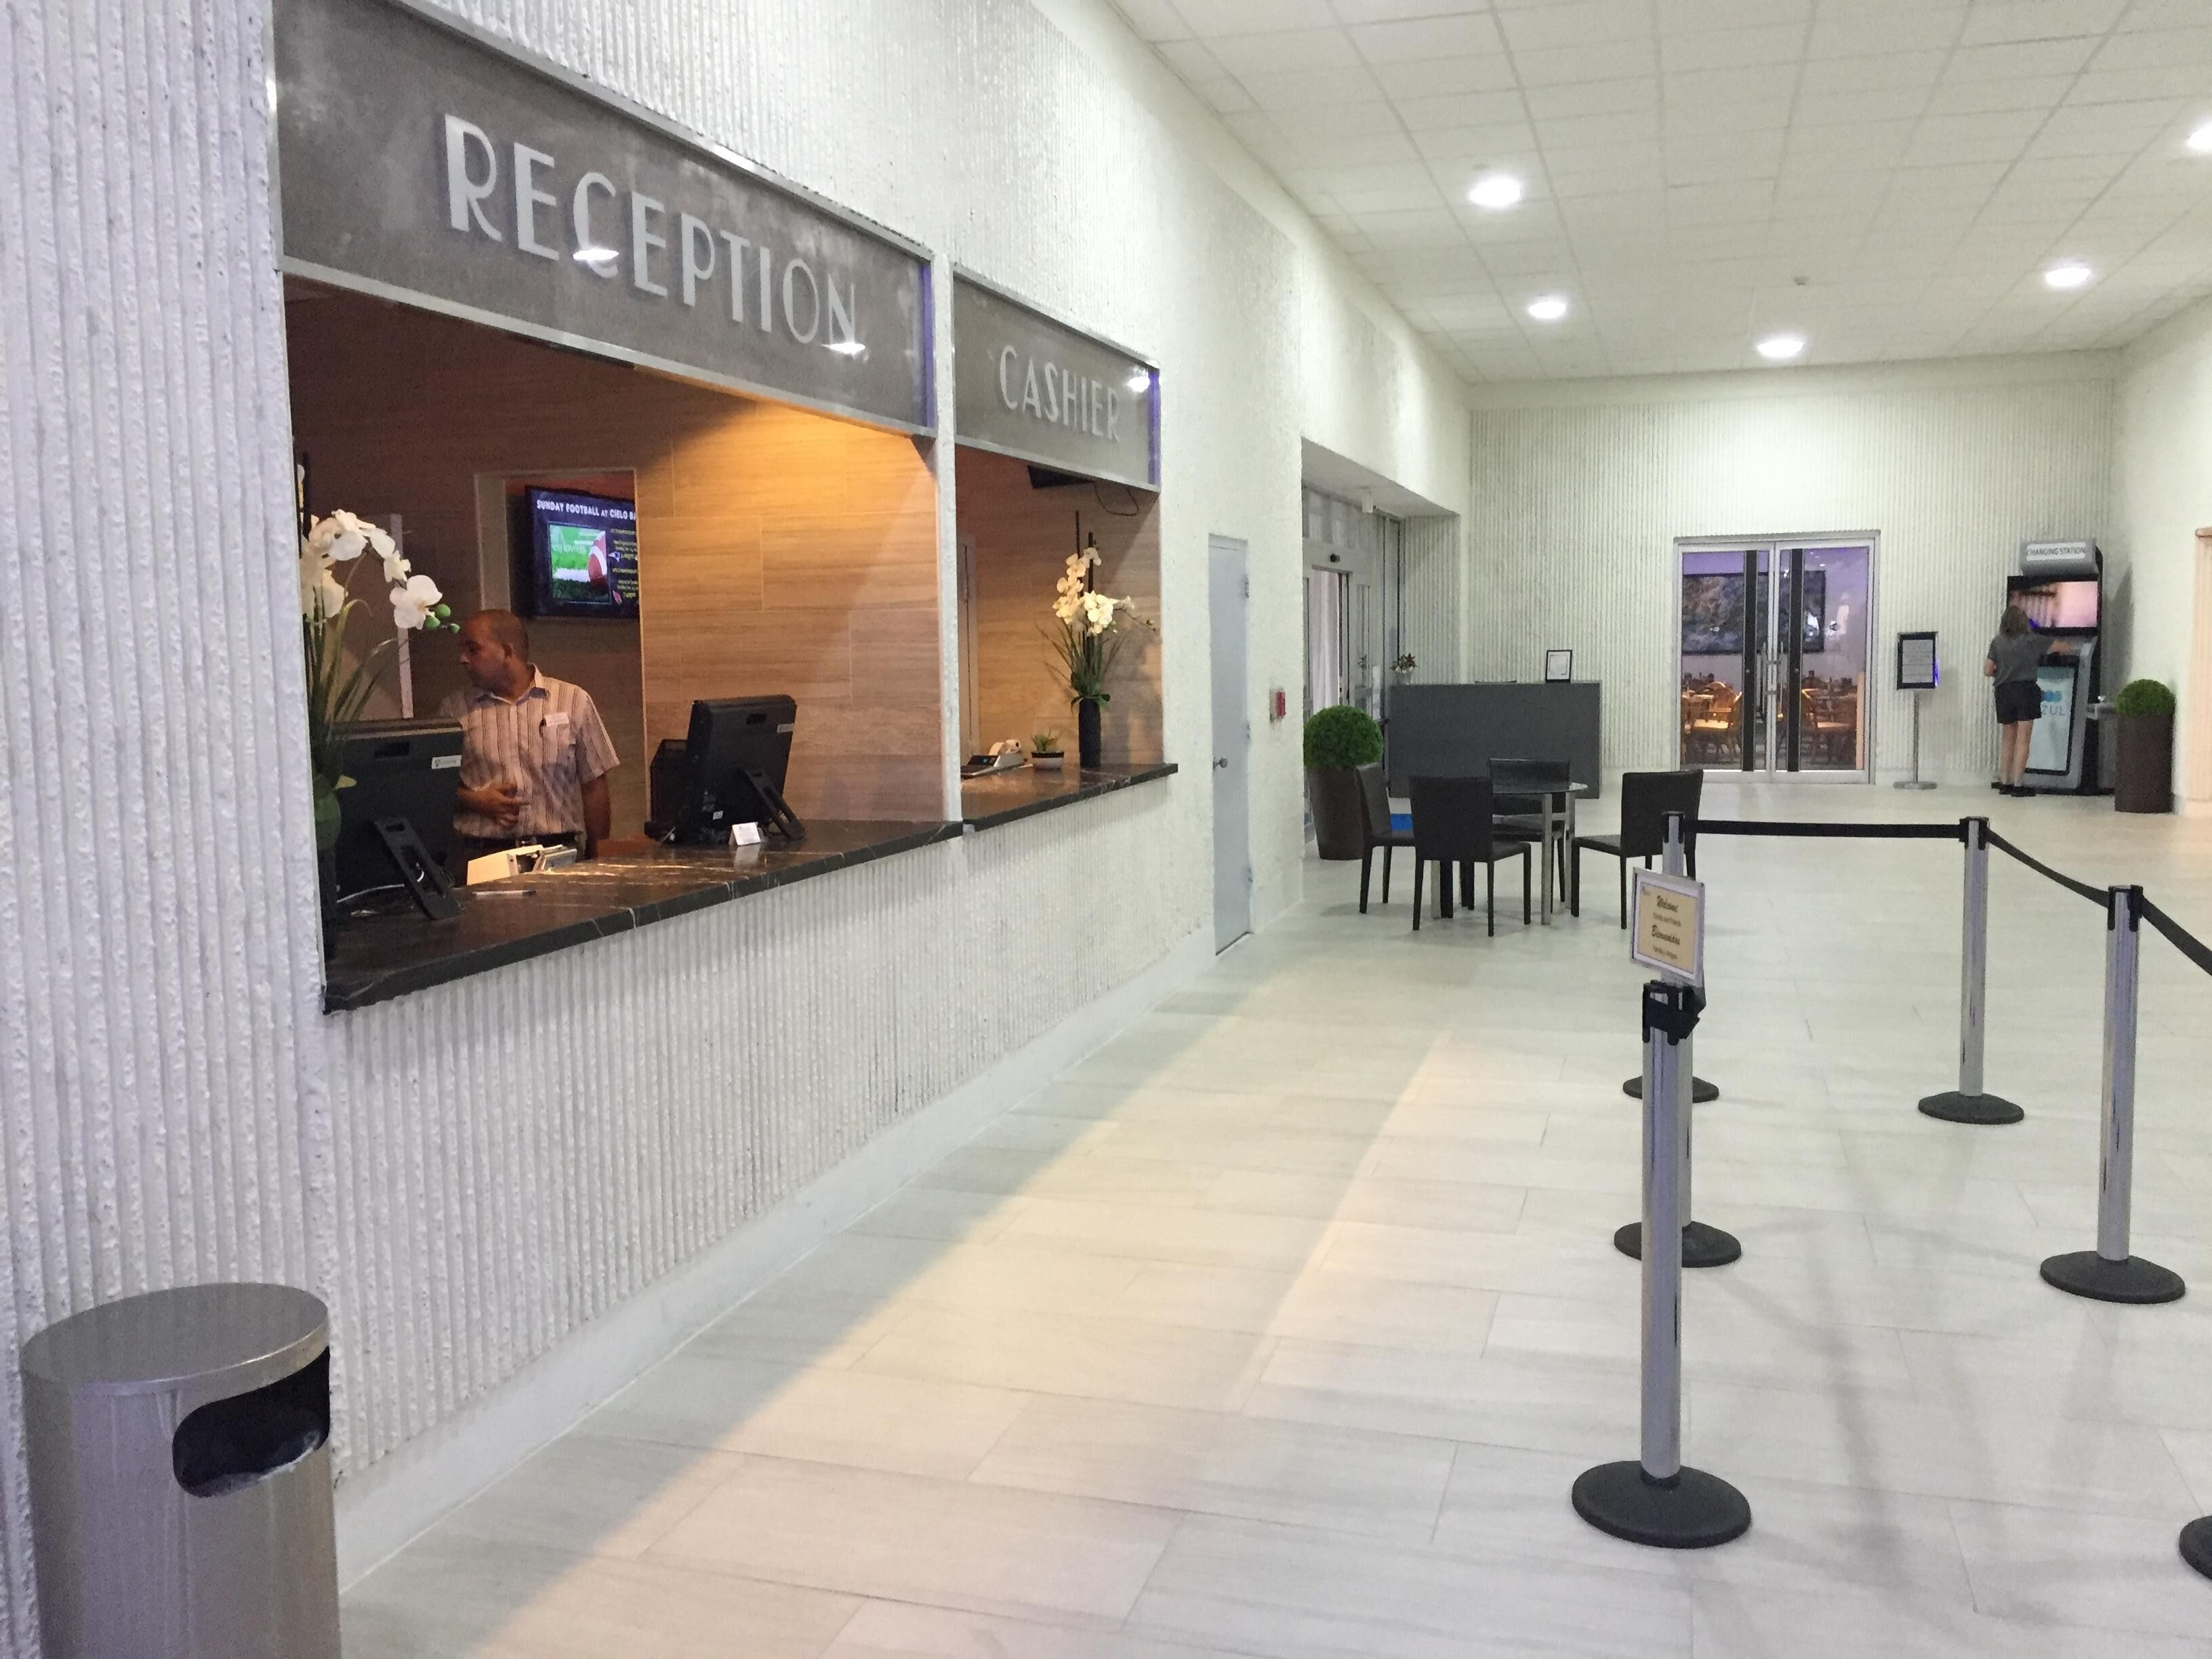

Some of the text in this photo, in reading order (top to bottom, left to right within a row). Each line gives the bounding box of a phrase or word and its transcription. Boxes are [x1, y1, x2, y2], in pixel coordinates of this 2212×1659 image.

[444, 114, 858, 352] RECEPTION
[999, 345, 1120, 443] CASHIER
[537, 499, 564, 512] SUNDAY
[566, 503, 599, 516] FOOTBALL
[609, 508, 628, 520] CIELO
[2028, 548, 2059, 556] CHARGING
[2041, 705, 2065, 716] ZUL
